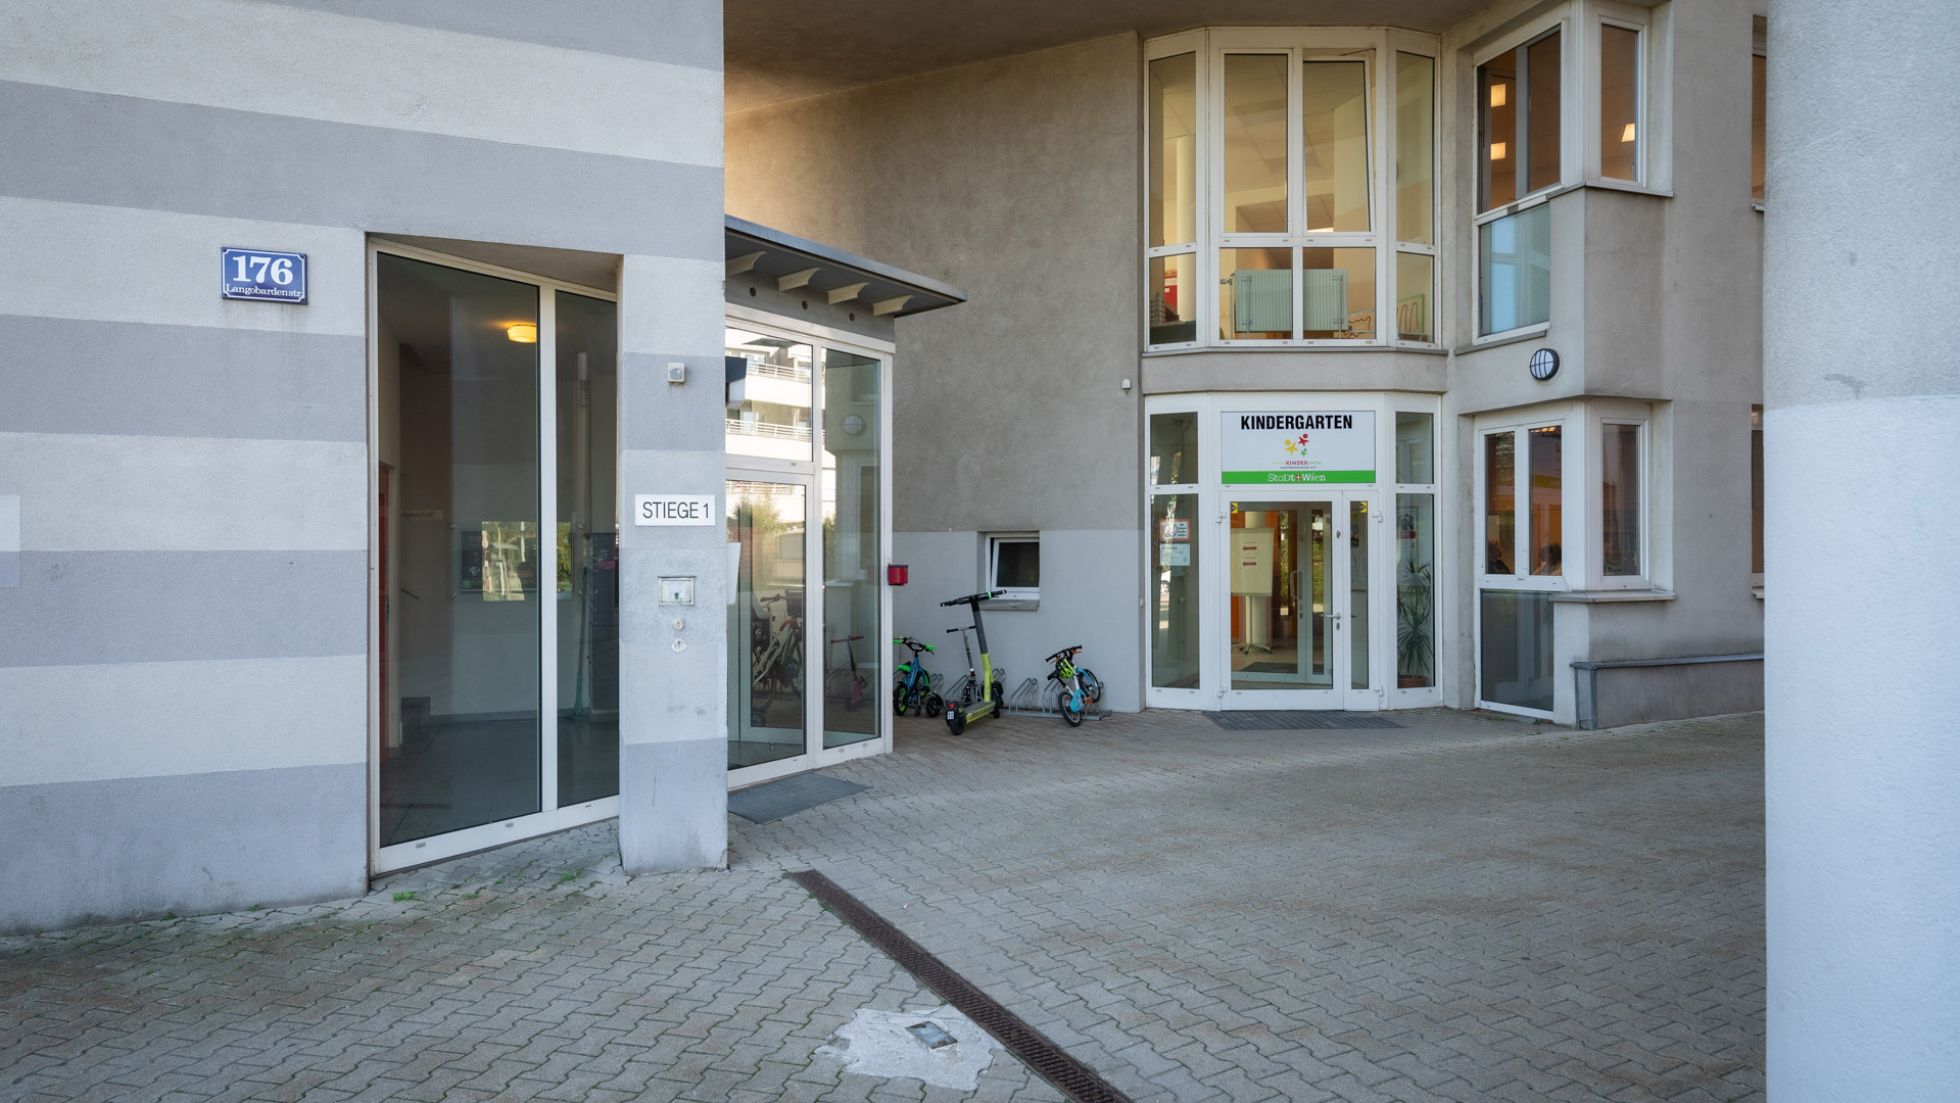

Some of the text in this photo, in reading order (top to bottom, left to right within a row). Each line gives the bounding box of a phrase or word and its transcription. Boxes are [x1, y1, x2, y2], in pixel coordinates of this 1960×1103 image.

[232, 255, 293, 285] 176
[1241, 415, 1352, 430] KINDERGARTEN
[642, 501, 709, 519] STIEGE 1
